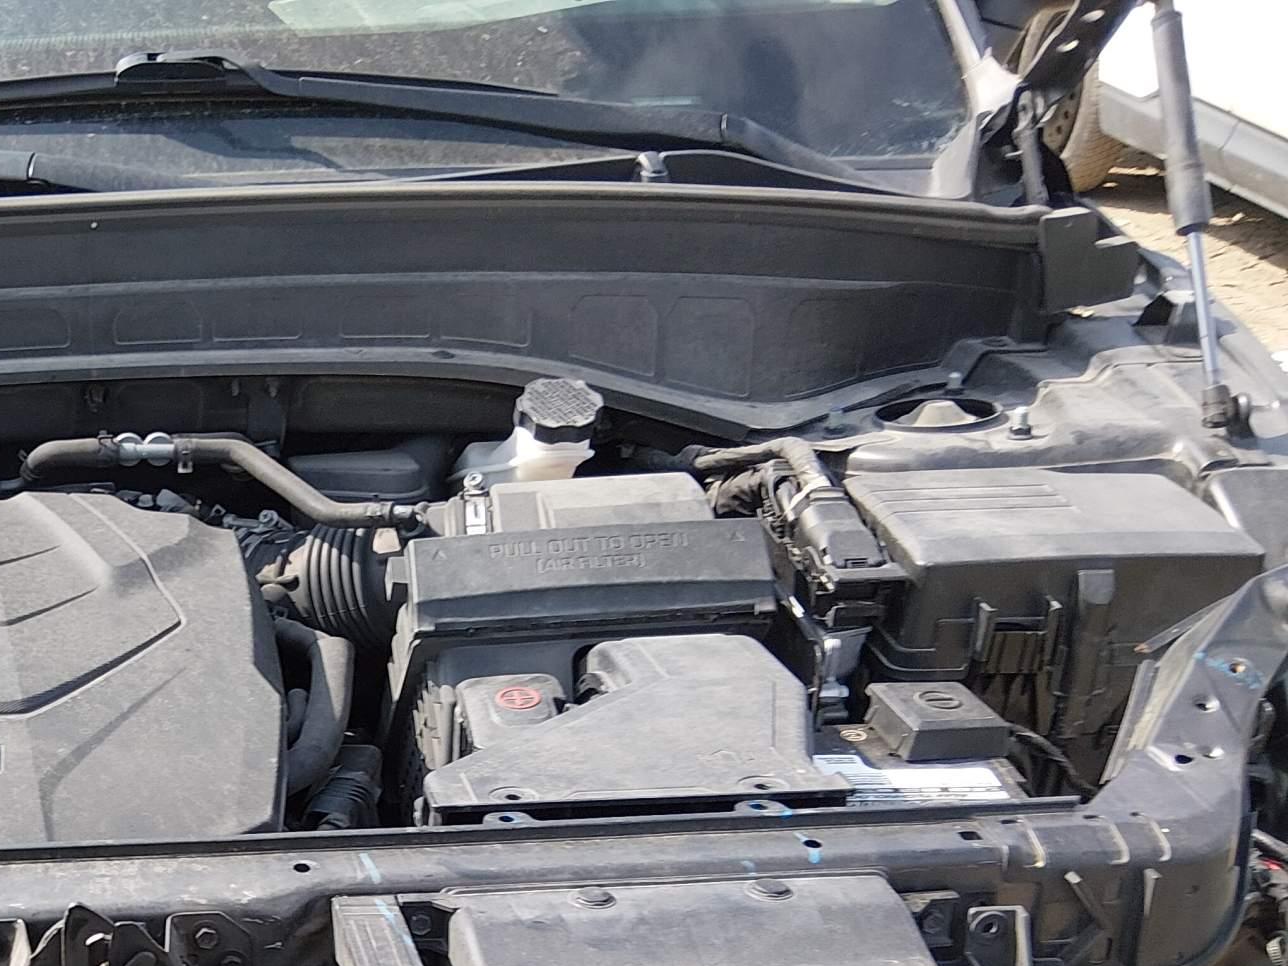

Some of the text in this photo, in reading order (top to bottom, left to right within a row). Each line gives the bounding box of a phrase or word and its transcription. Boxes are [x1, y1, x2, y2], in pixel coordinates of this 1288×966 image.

[488, 532, 690, 559] PULL OUT TO OPEN
